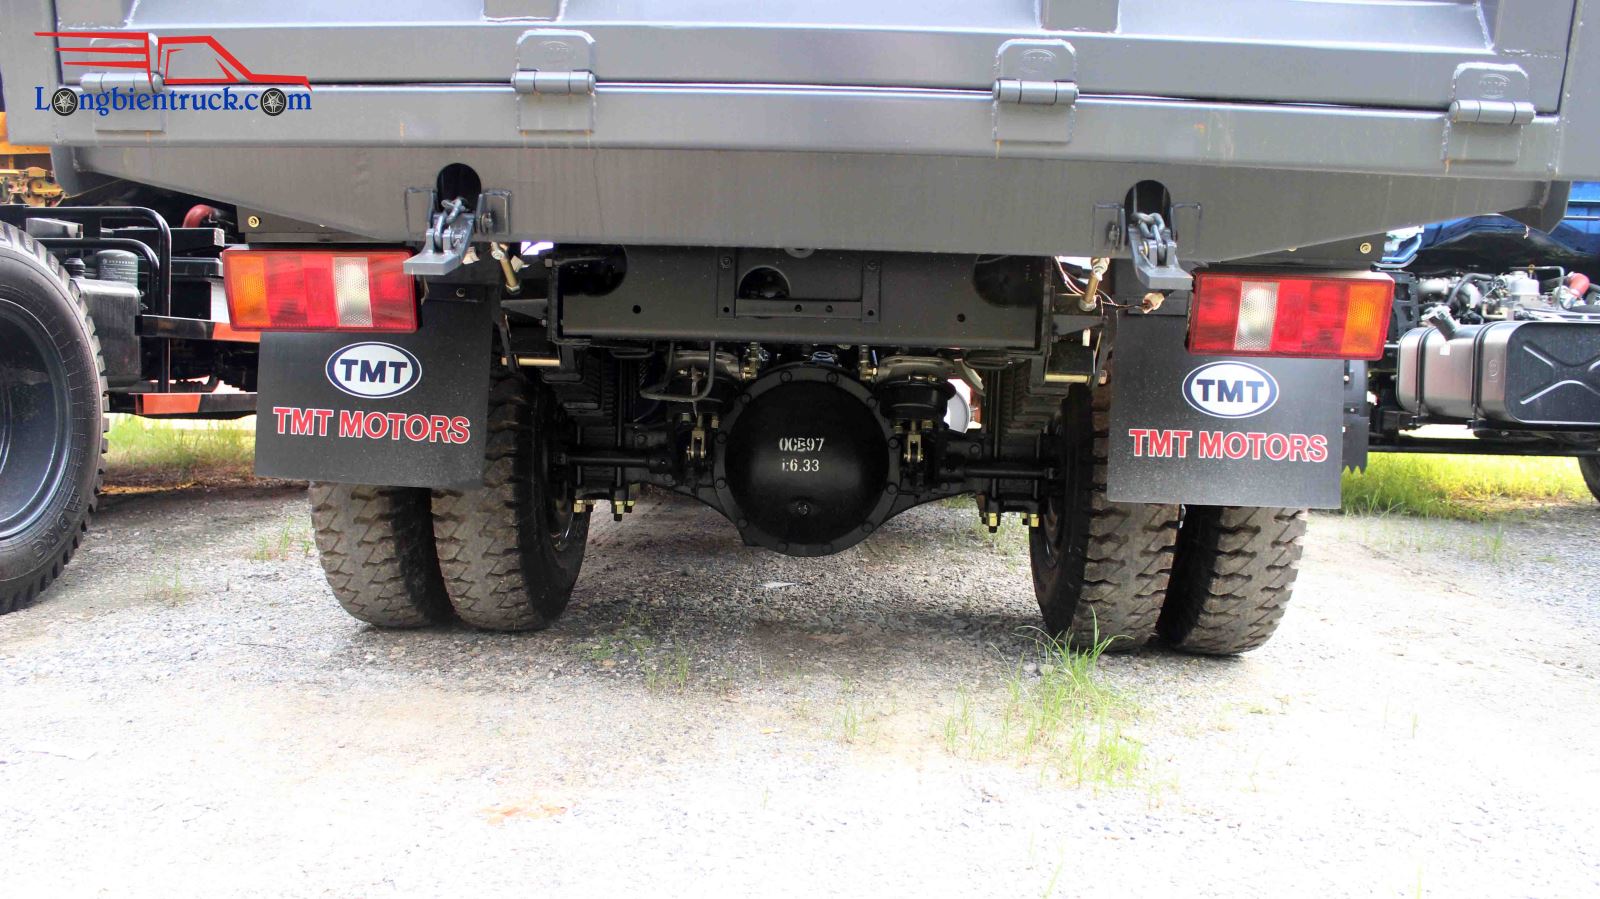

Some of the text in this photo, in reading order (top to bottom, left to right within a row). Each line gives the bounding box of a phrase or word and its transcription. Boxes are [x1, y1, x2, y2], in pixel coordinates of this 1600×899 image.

[340, 358, 408, 384] TMT
[1196, 379, 1264, 403] TMT
[273, 406, 471, 444] TMT MOTORS
[1128, 428, 1328, 463] TMT MOTORS
